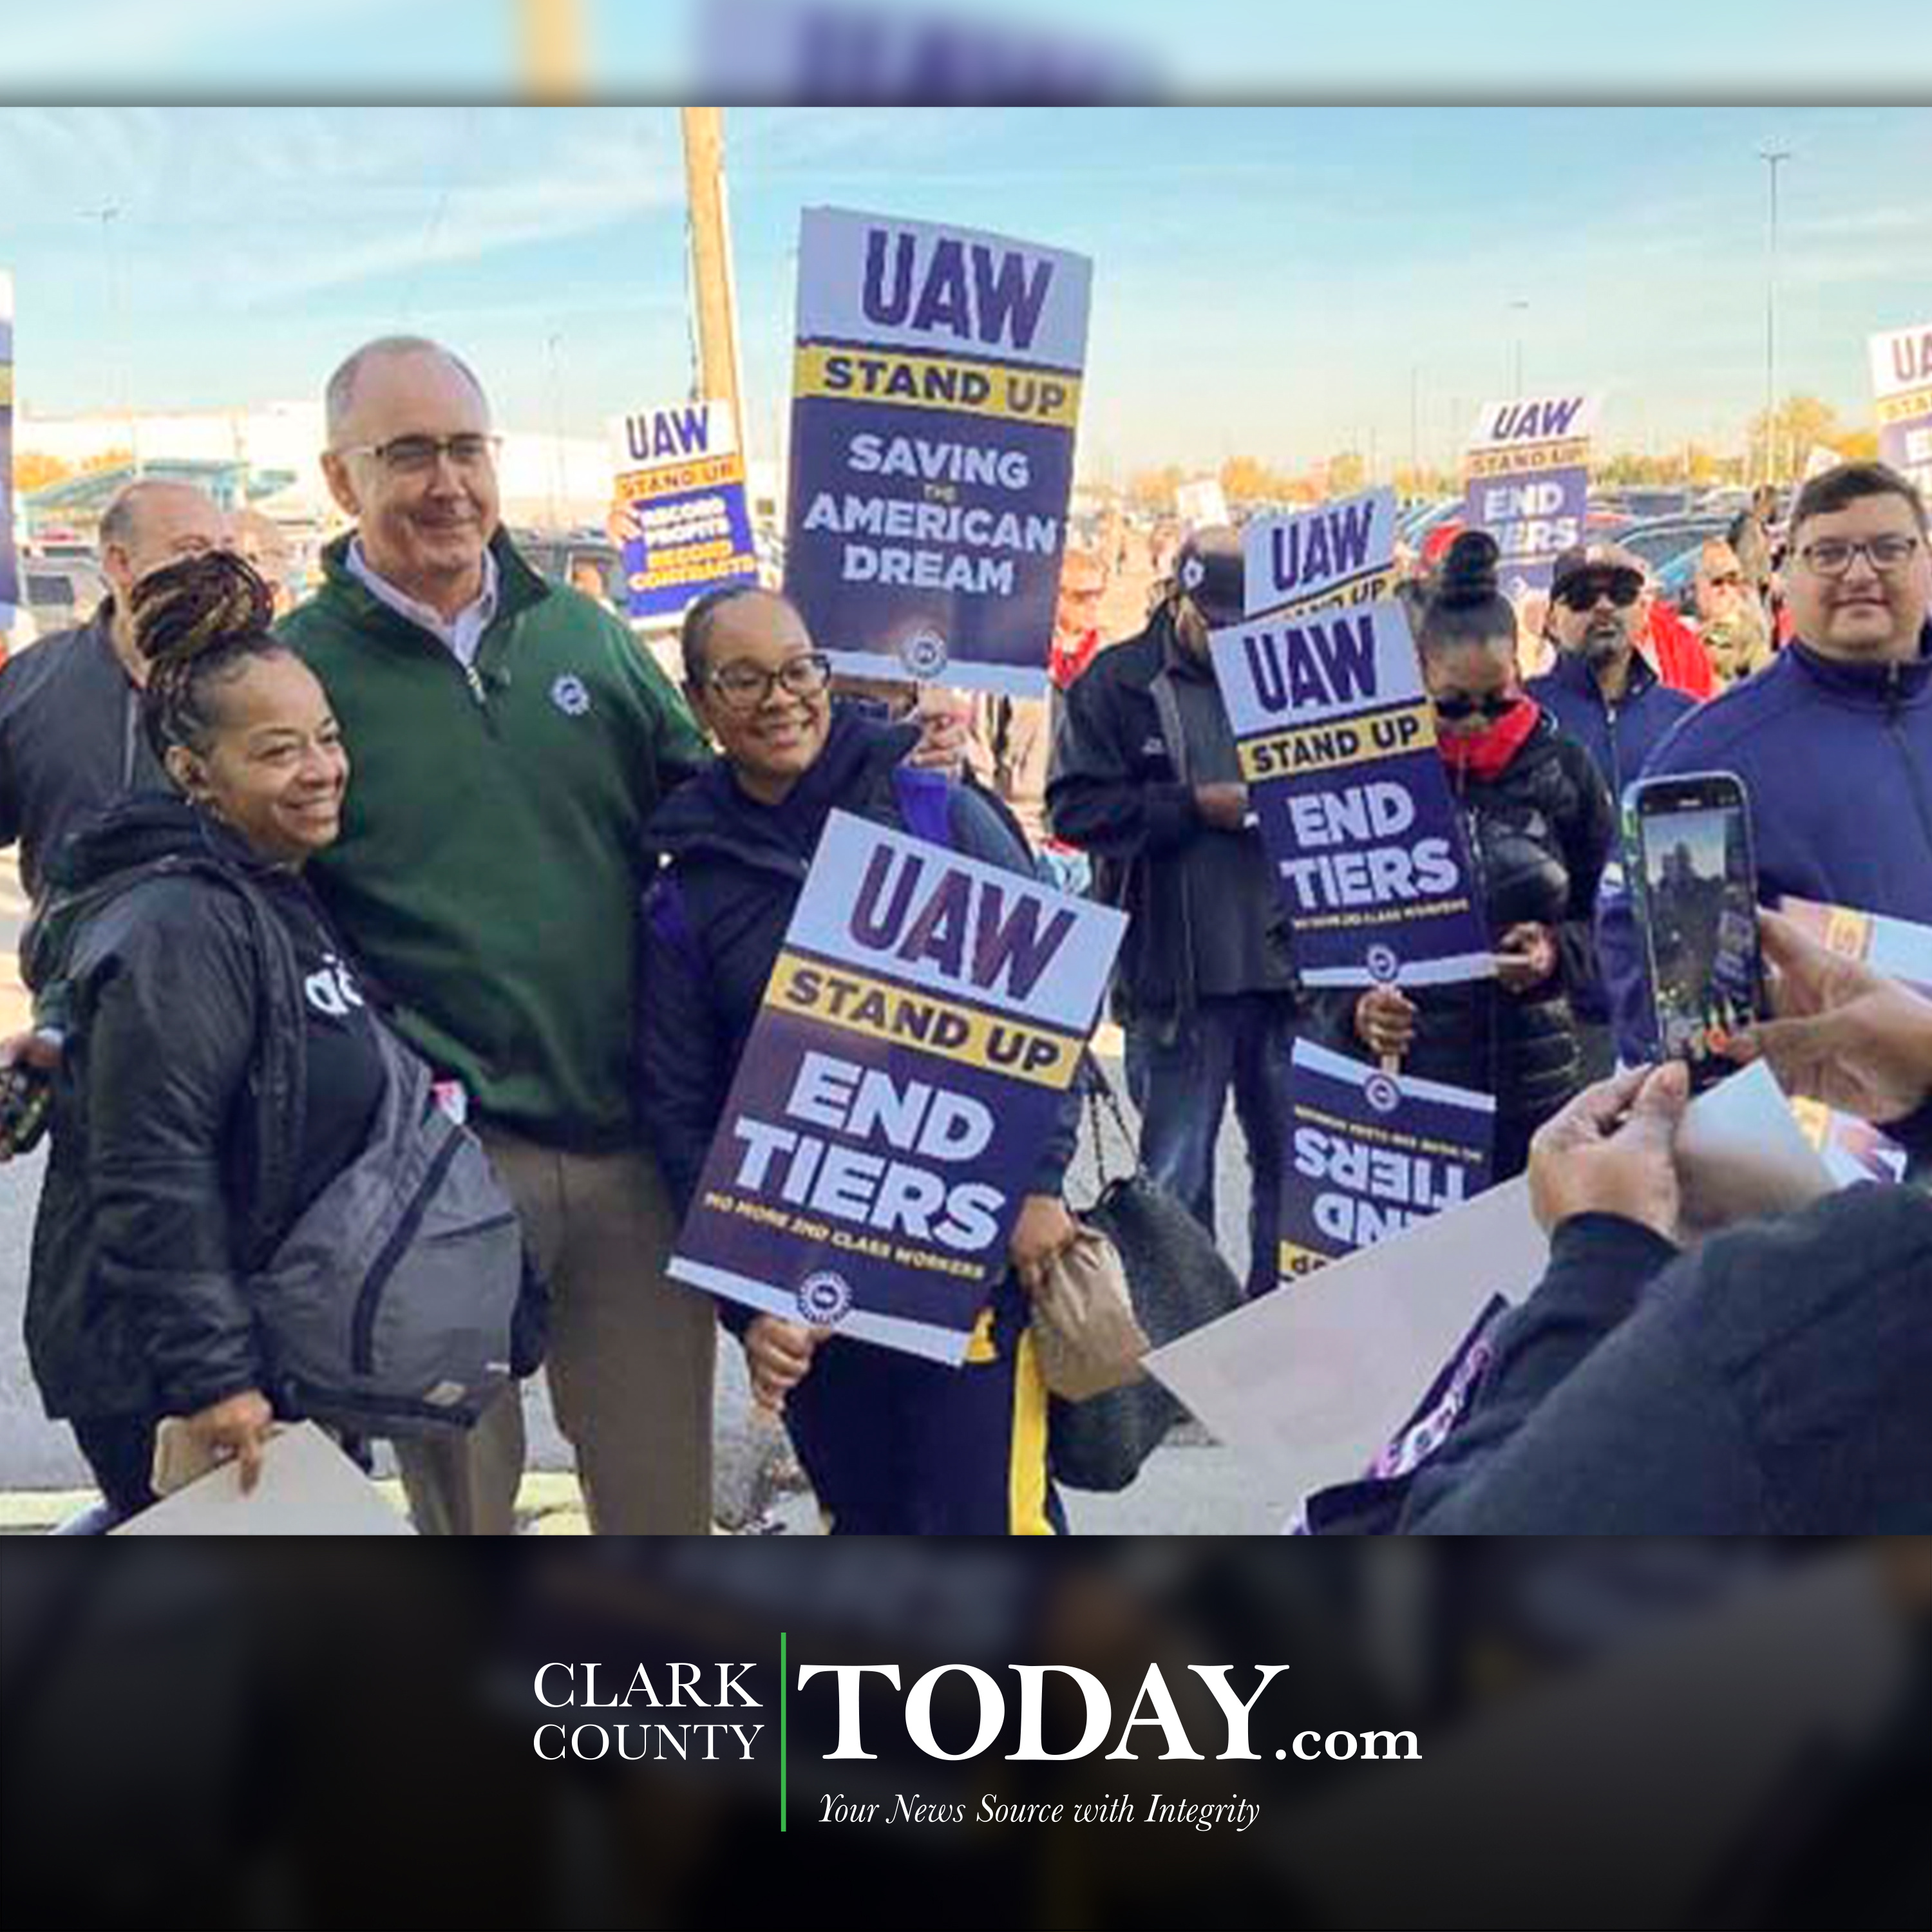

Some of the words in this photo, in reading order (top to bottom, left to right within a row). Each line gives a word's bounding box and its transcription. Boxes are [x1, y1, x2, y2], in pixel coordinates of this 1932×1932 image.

[861, 229, 1054, 348] UAW
[824, 355, 990, 412] STAND
[1006, 377, 1066, 416] UP
[1892, 332, 1932, 381] UA
[625, 405, 708, 460] UAW
[1491, 397, 1584, 440] UAW
[620, 468, 696, 498] STAND
[848, 433, 1029, 490] SAVING
[1472, 451, 1545, 473] STAND
[802, 493, 1057, 554] AMERICAN
[1484, 482, 1564, 523] END
[842, 546, 1014, 596] DREAM
[1272, 500, 1374, 592] UAW
[1243, 615, 1378, 715] UAW
[1251, 728, 1359, 774] STAND
[1373, 714, 1419, 749] UP
[1287, 781, 1416, 848] END
[1281, 837, 1460, 910] TIERS
[849, 842, 1077, 1001] UAW
[785, 970, 971, 1053] STAND
[985, 1033, 1061, 1074] UP
[786, 1051, 996, 1161] END
[733, 1115, 1007, 1252] TIERS
[1294, 1126, 1471, 1208] TIERS
[1312, 1191, 1417, 1247] ND
